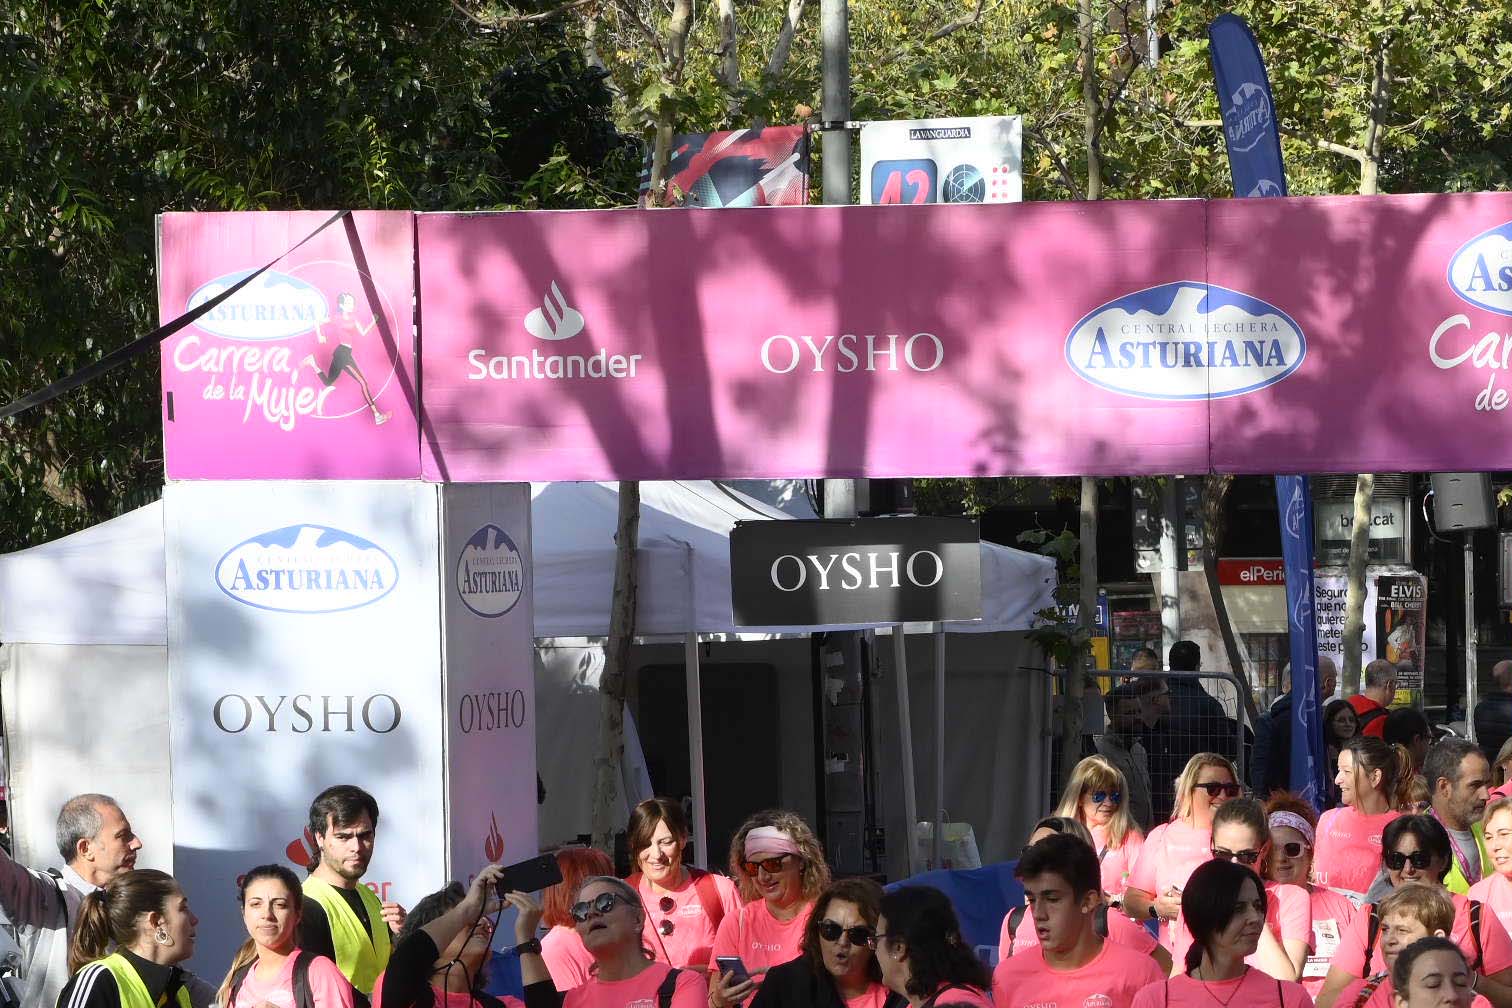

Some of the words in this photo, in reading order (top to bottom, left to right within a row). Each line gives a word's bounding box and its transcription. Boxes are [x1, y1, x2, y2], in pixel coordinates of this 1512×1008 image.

[919, 127, 970, 138] VANGUARDIA
[1121, 323, 1193, 335] CENTRAL
[174, 335, 291, 373] Carrera
[468, 349, 643, 380] Santander
[761, 333, 945, 374] OYSHO
[1085, 326, 1287, 370] ASTURIANA
[204, 374, 226, 401] de
[229, 374, 245, 401] la
[244, 366, 335, 431] Mujer
[1475, 374, 1509, 411] de
[230, 557, 385, 592] ASTURIANA
[462, 564, 521, 595] ASTURIANA
[770, 550, 943, 592] OYSHO
[1316, 602, 1334, 612] que
[213, 693, 402, 734] OYSHO
[459, 690, 525, 734] OYSHO
